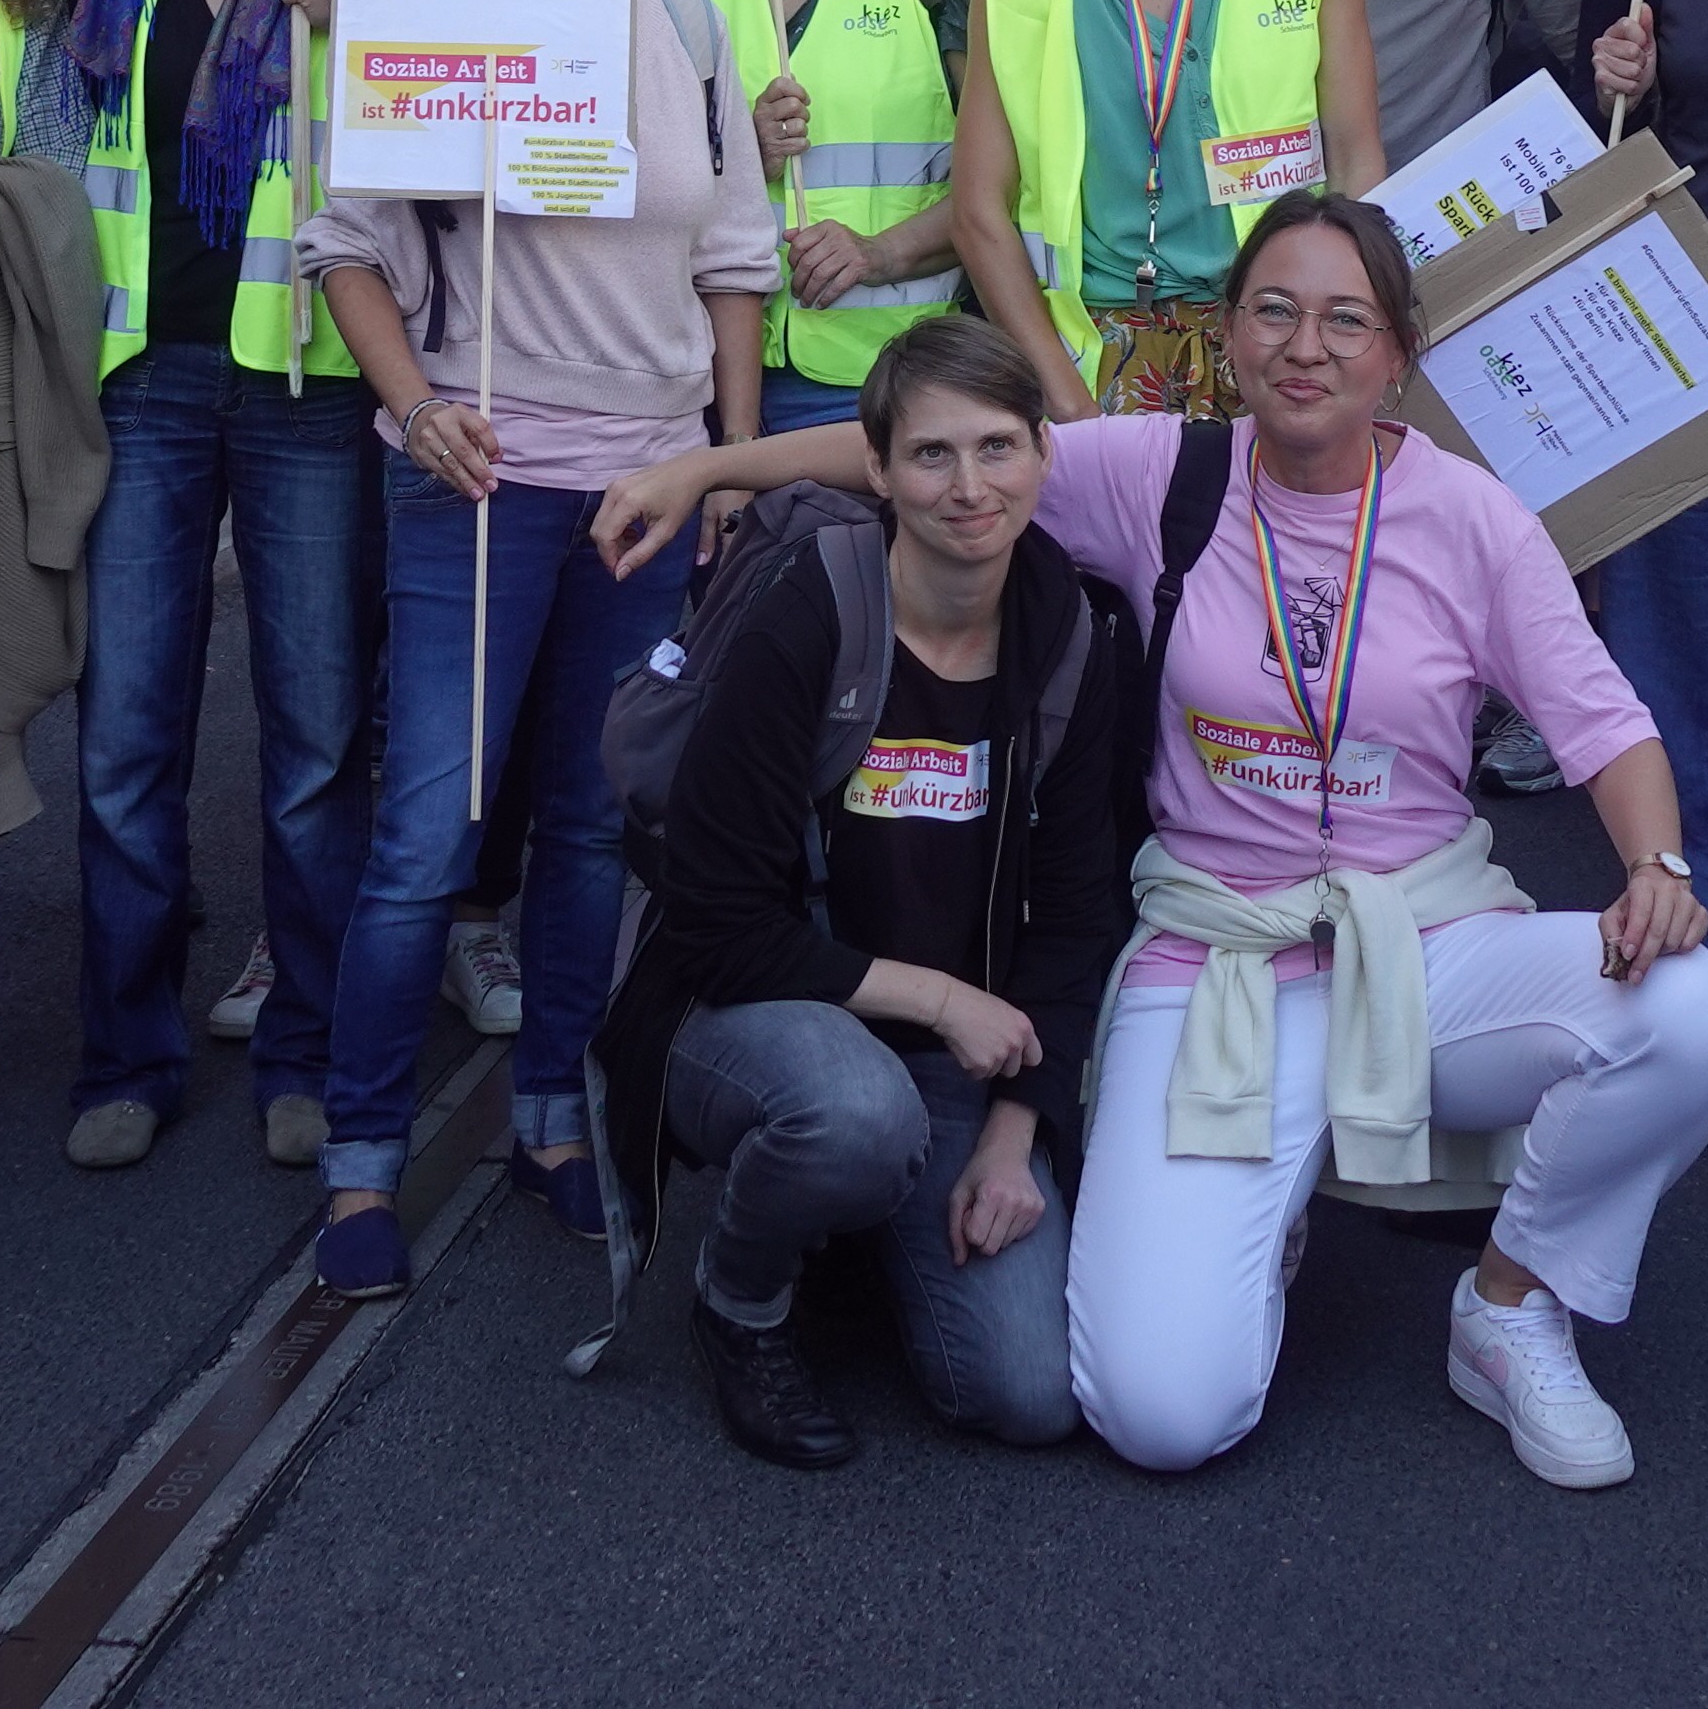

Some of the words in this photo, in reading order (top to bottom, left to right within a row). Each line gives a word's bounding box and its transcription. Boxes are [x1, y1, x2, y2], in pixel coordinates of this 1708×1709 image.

[844, 16, 888, 30] oase
[863, 4, 901, 23] kiez
[1257, 6, 1304, 28] oase
[369, 57, 448, 78] Soziale
[455, 58, 528, 80] Areit
[362, 102, 385, 119] ist
[1217, 140, 1273, 163] Soziale
[1514, 137, 1549, 179] Mobile
[1549, 147, 1567, 165] 76
[1500, 153, 1513, 173] ist
[1514, 173, 1535, 195] 100
[1218, 182, 1237, 196] ist
[828, 710, 863, 720] deuter
[1197, 720, 1262, 751] Soziale
[910, 751, 963, 775] Arbeit
[850, 786, 866, 805] ist
[870, 781, 990, 812] #unkürzbar
